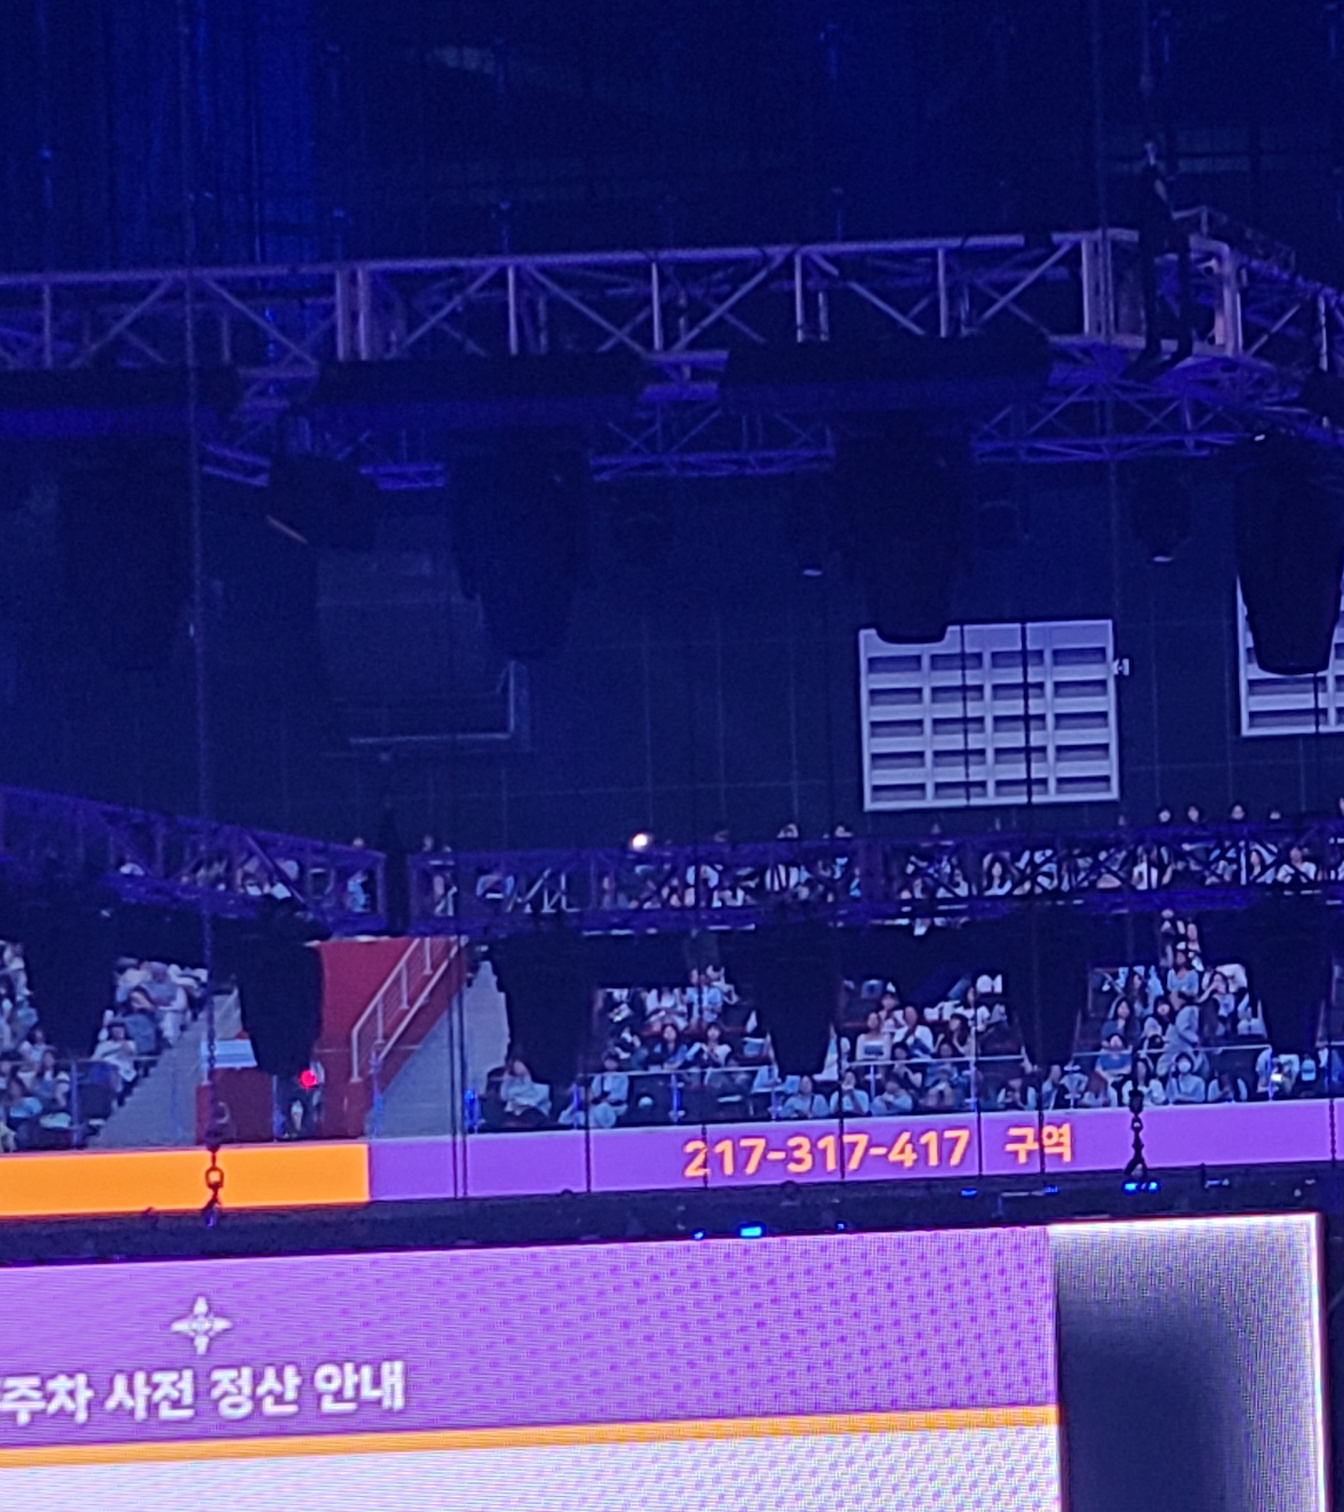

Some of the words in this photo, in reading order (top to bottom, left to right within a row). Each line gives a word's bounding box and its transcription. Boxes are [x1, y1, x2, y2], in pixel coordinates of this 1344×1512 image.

[682, 1128, 971, 1179] 217-317-417
[1004, 1122, 1073, 1164] 구역
[0, 1372, 95, 1427] 주차
[104, 1367, 196, 1423] 사전
[209, 1364, 303, 1421] 정산
[313, 1359, 406, 1414] 안내
